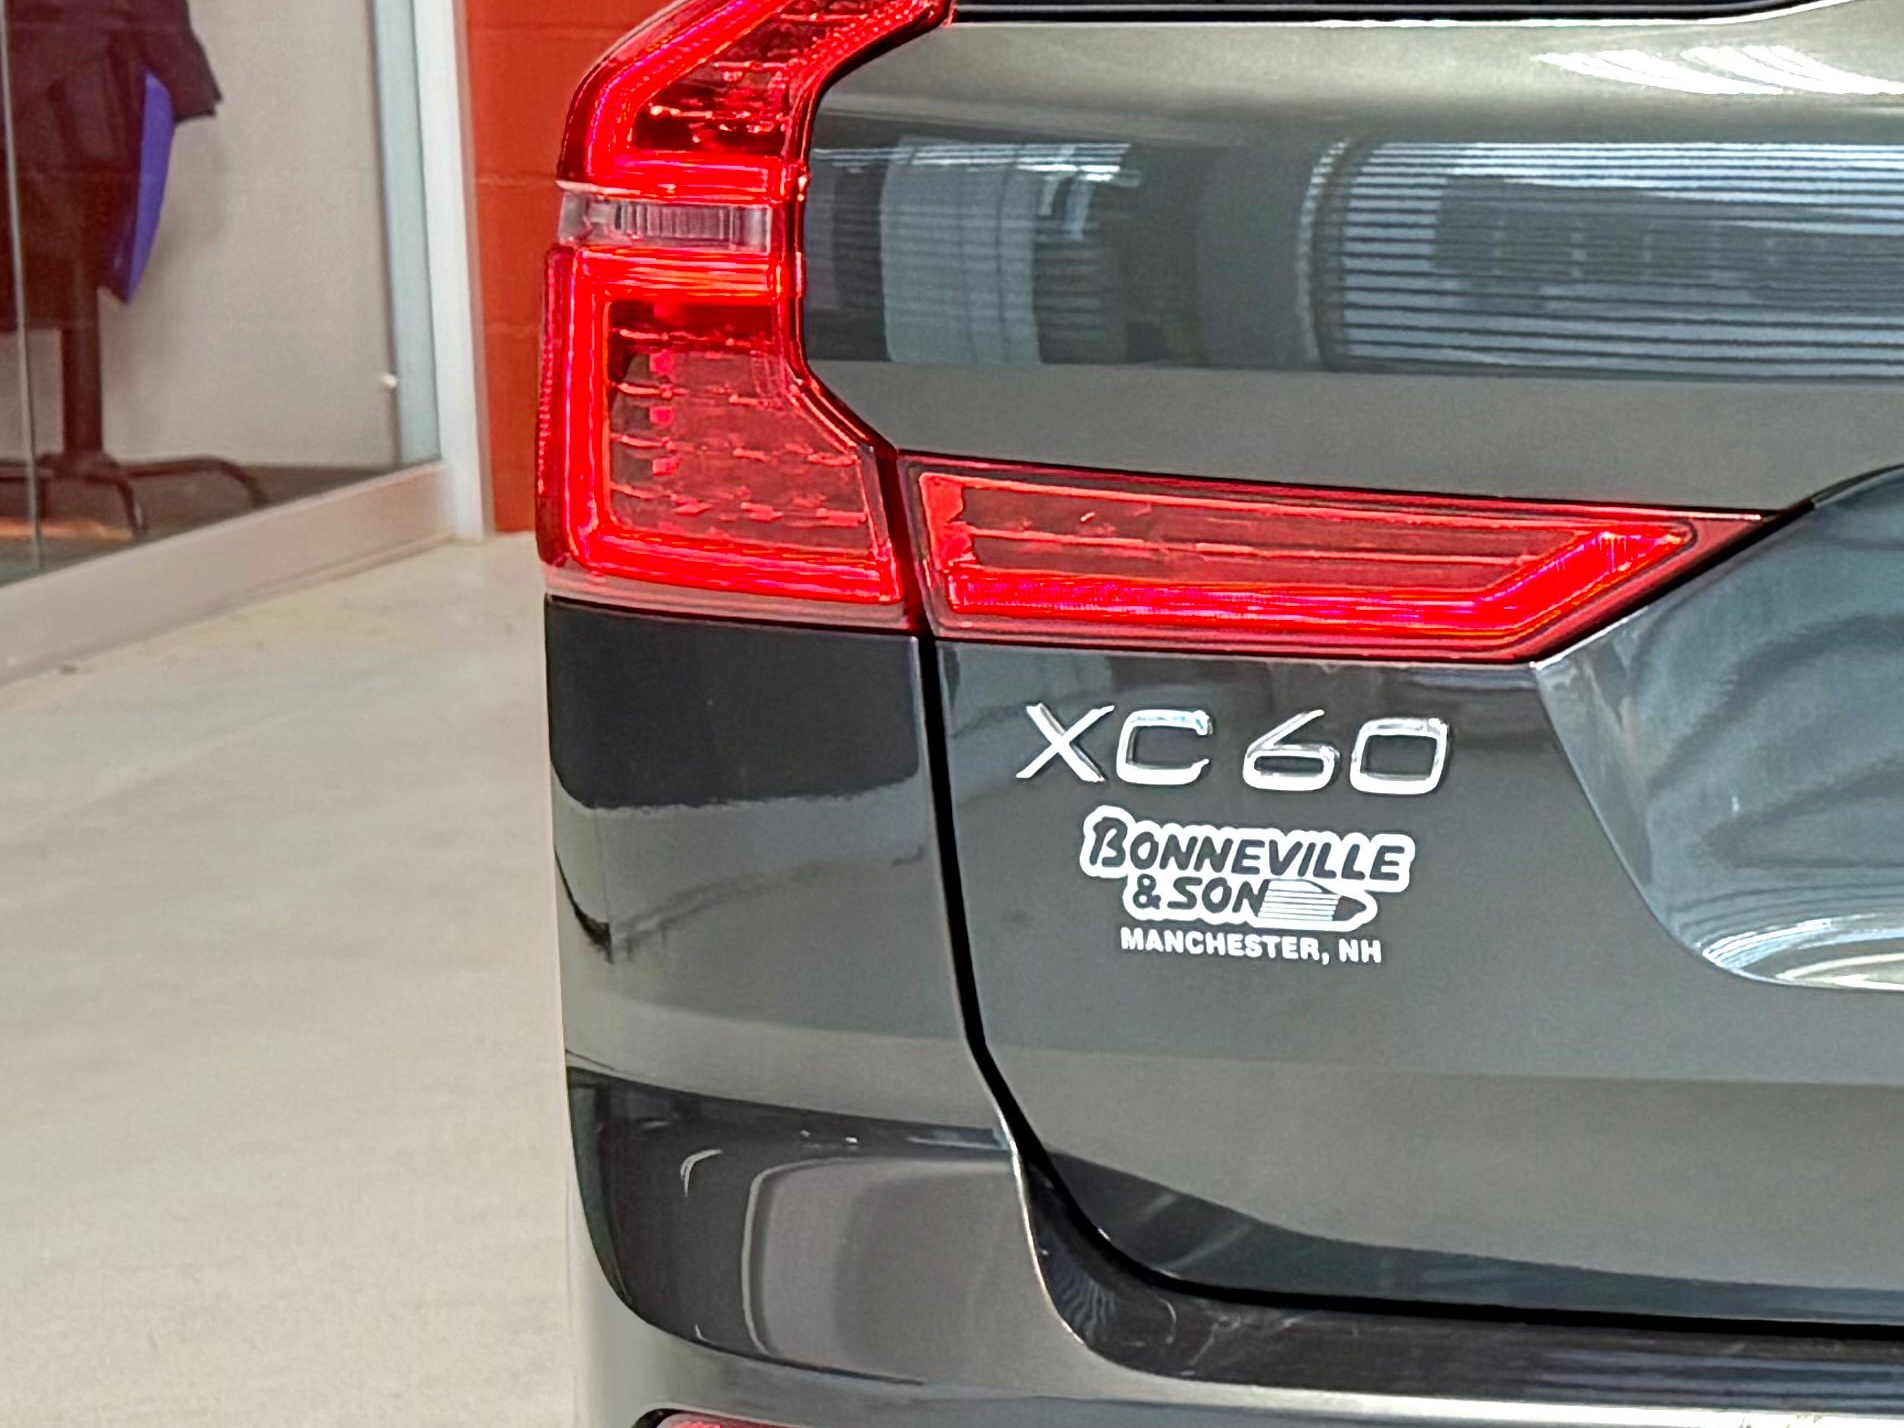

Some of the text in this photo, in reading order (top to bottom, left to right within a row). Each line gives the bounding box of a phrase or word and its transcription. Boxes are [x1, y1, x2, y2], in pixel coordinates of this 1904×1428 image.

[1088, 815, 1406, 881] BONNEVILLE
[1120, 926, 1383, 965] MANCHESTER, NH
